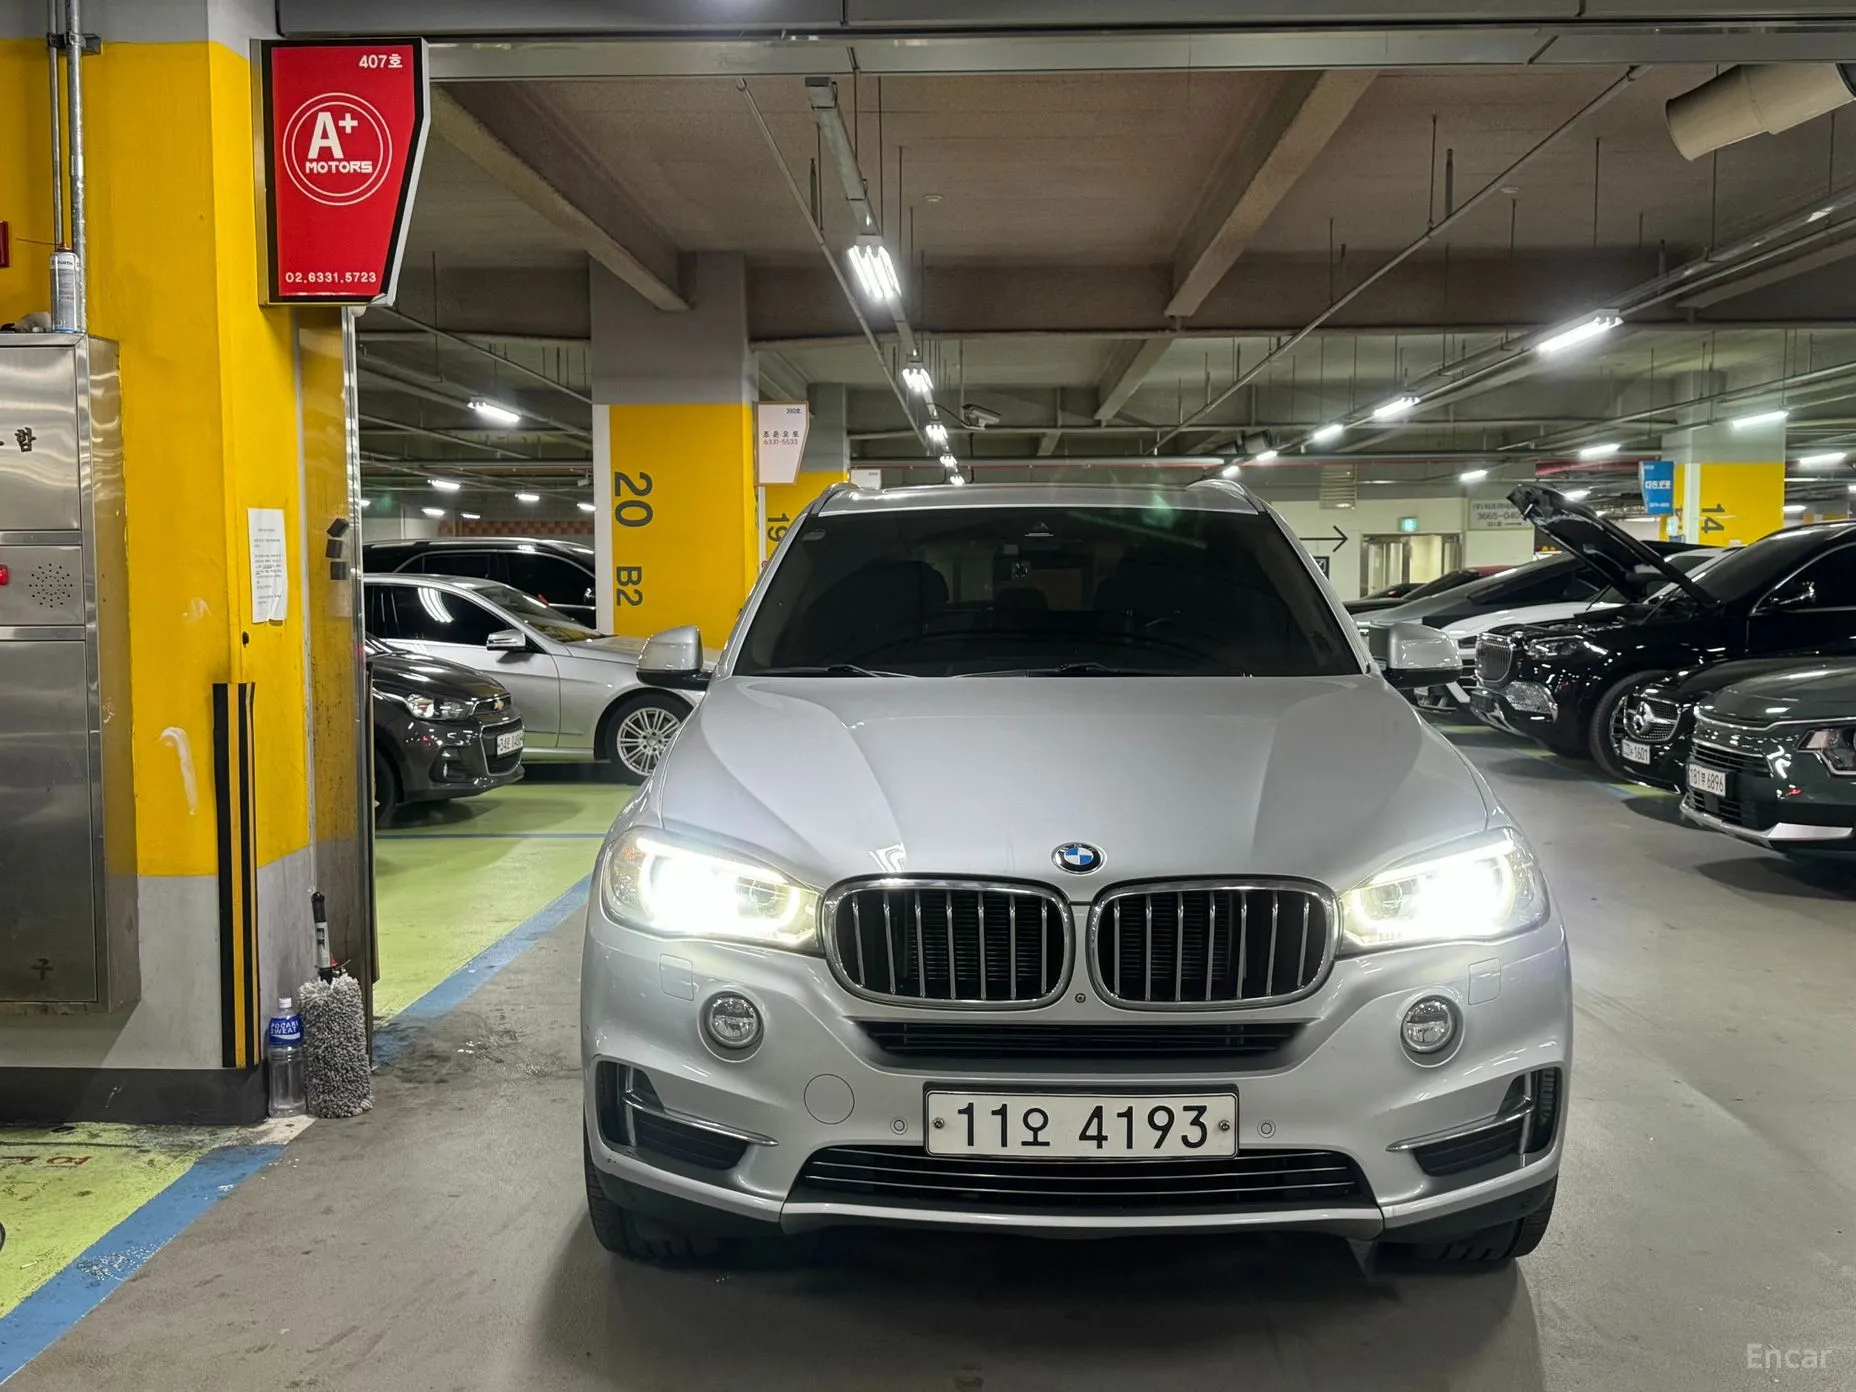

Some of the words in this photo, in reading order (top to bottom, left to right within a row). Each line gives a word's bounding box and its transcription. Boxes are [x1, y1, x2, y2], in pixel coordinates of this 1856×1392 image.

[358, 53, 403, 69] 407호
[307, 111, 358, 159] A+
[305, 161, 373, 174] MOTORS
[285, 272, 377, 284] 02.6331.5723
[614, 471, 653, 527] 20
[767, 512, 790, 543] 19
[1701, 503, 1725, 534] 14
[616, 566, 643, 606] B2
[1707, 773, 1724, 793] 6896
[270, 1021, 299, 1029] POCARI
[270, 1027, 298, 1035] SWEAT
[957, 1102, 1050, 1148] 11오
[1078, 1105, 1208, 1150] 4193
